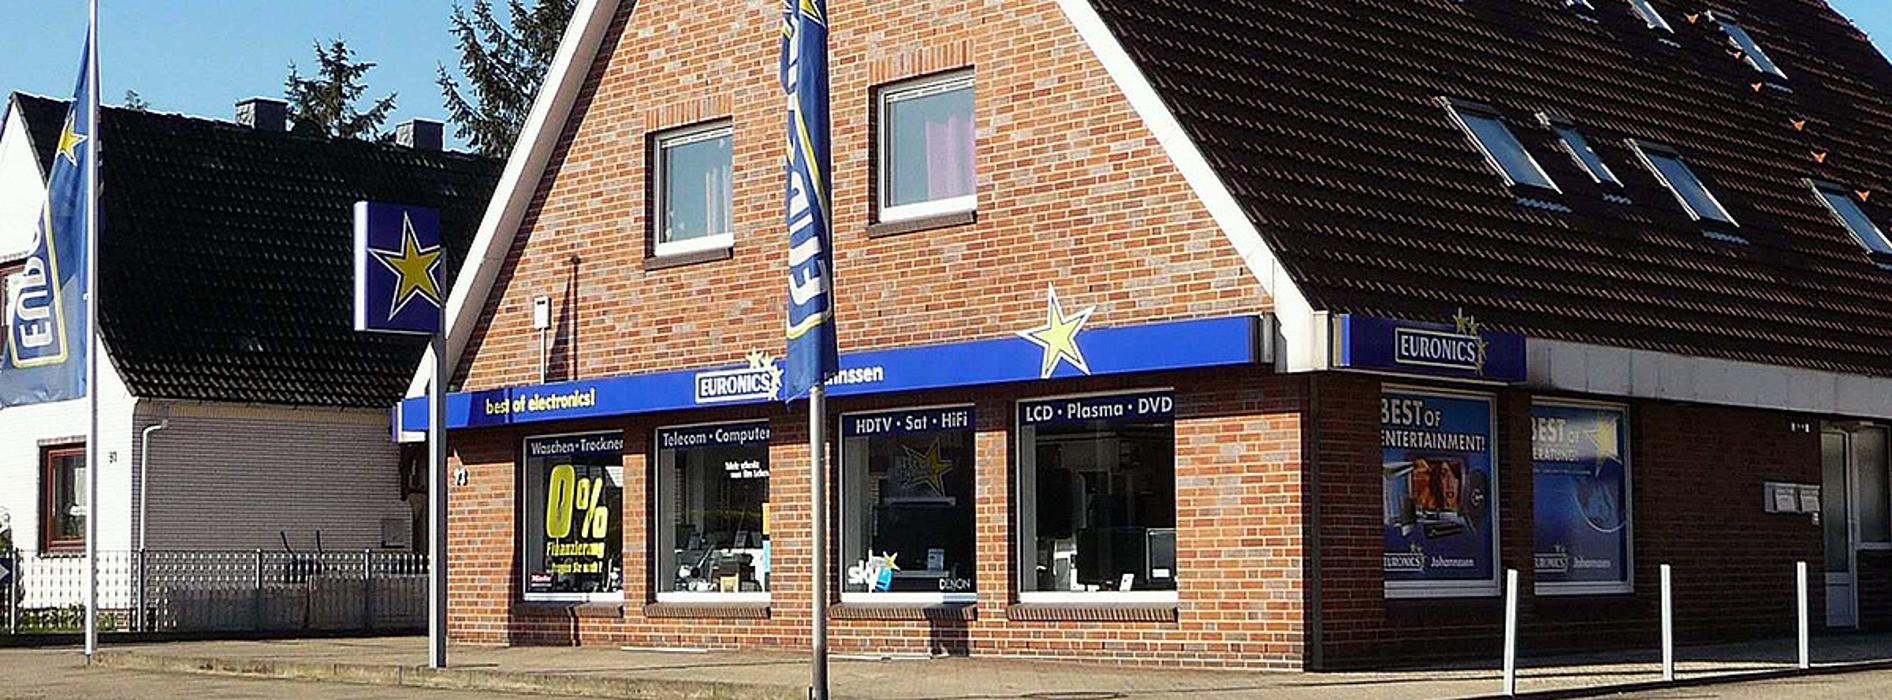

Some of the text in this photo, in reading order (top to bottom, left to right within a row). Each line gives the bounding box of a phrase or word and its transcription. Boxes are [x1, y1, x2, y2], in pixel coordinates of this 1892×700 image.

[1401, 335, 1476, 363] EURONICS
[700, 372, 771, 396] EURONICS
[486, 387, 595, 414] best of electronics!
[1025, 397, 1172, 421] LCD Plasma DVD
[856, 411, 968, 433] HDTV Sat HiFi
[1425, 410, 1441, 427] OF
[531, 437, 624, 455] Waschen Trockner
[663, 426, 770, 447] Telecom Computer
[546, 464, 609, 539] 0%
[939, 578, 970, 591] DENON
